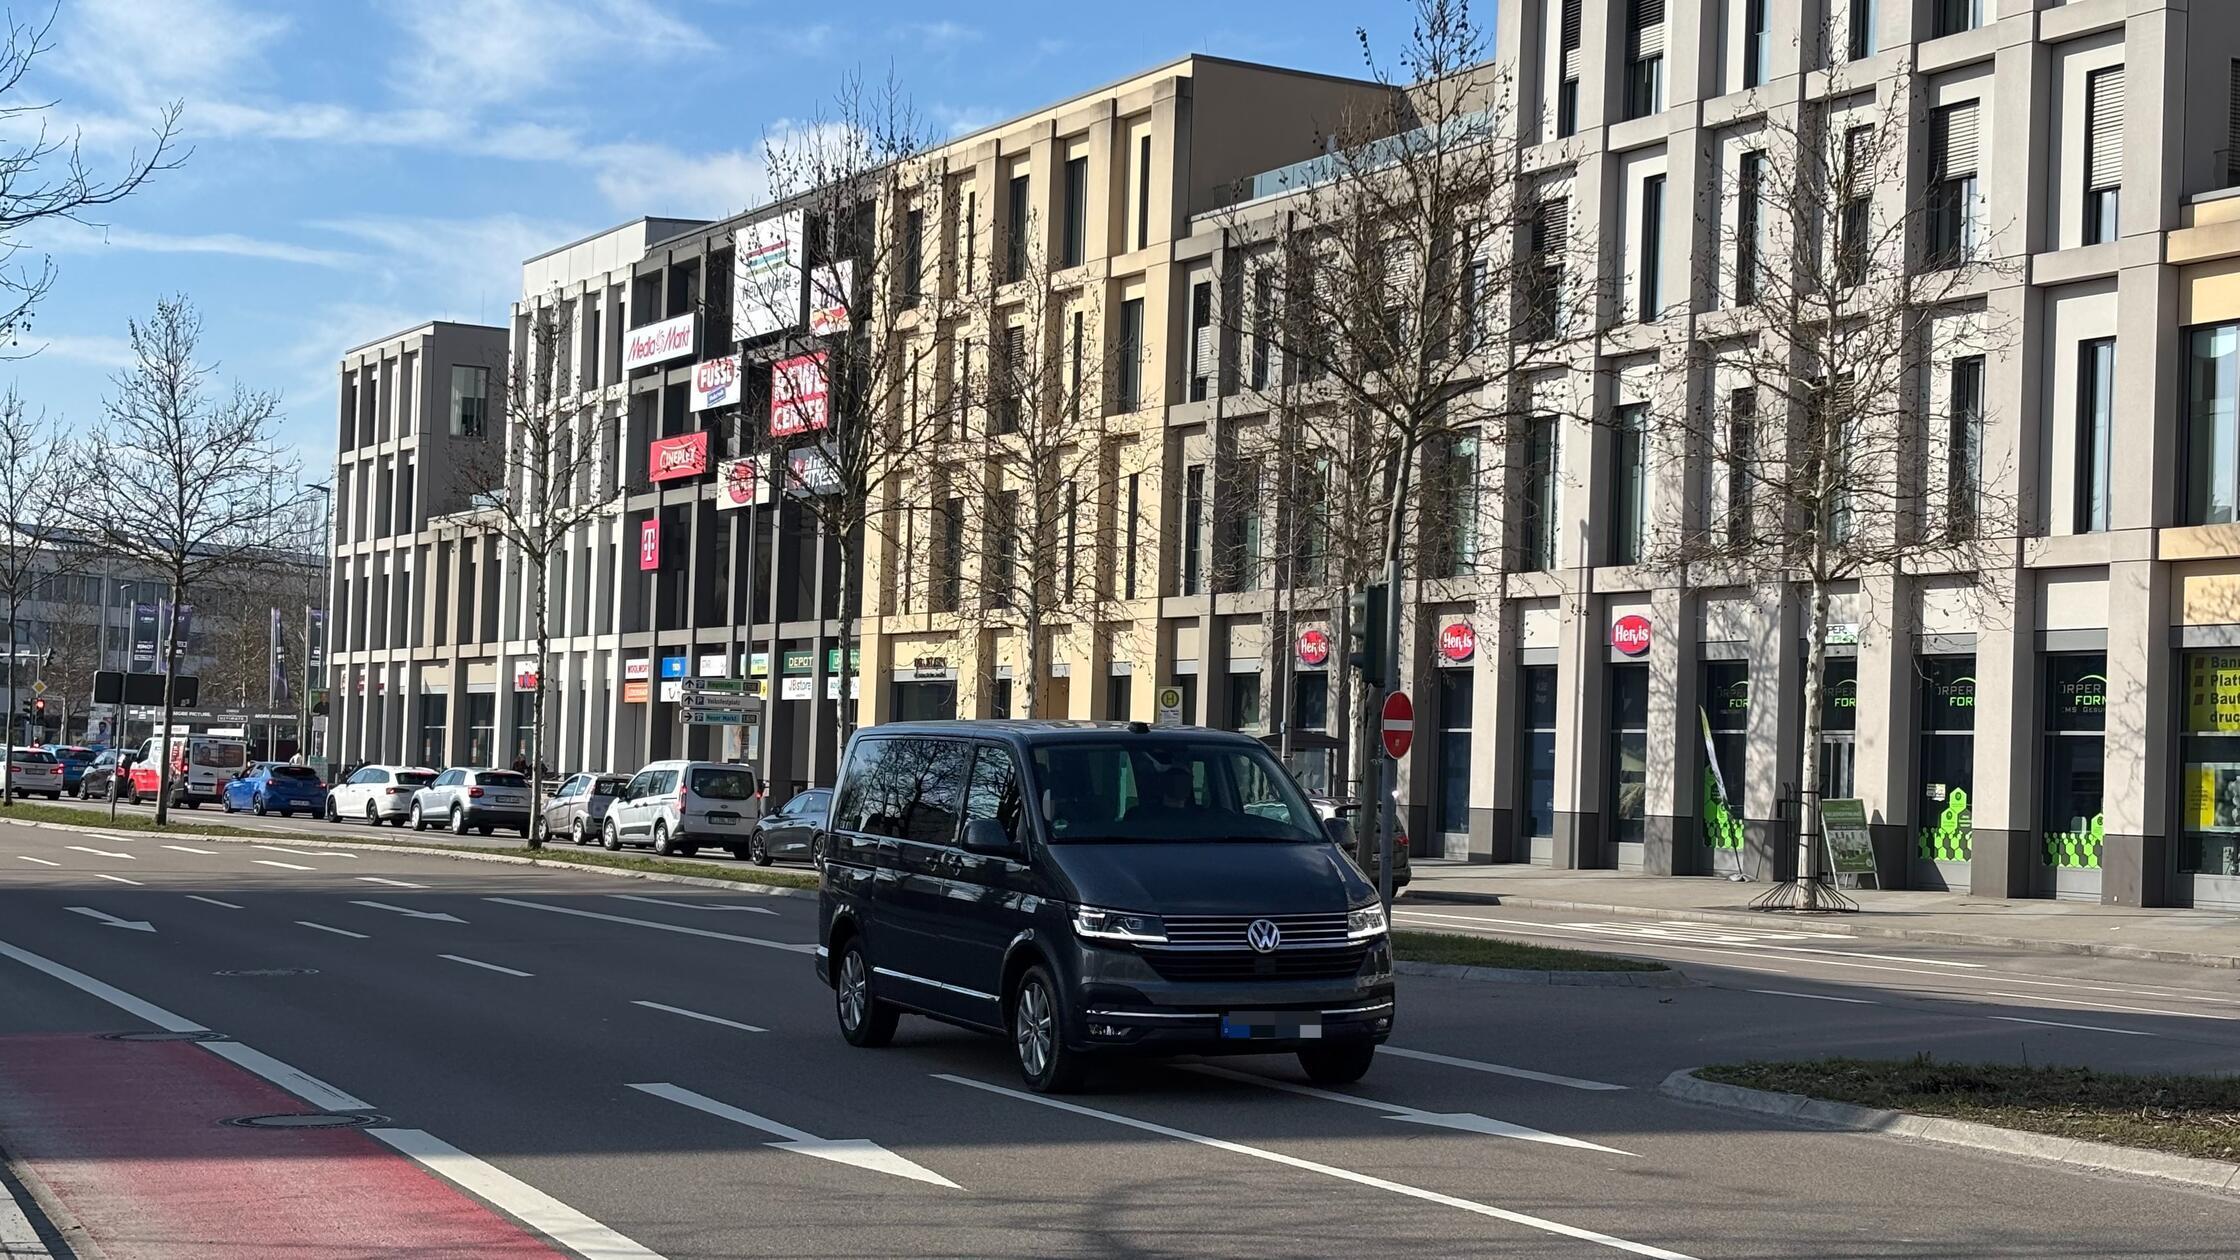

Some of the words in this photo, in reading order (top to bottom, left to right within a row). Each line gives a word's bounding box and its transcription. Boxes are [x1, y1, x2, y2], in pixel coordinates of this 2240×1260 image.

[627, 336, 656, 362] Media
[663, 325, 690, 352] Markt
[1443, 632, 1473, 652] Hervis
[1615, 624, 1649, 646] Hervis
[1300, 637, 1326, 657] Hervis
[788, 657, 813, 668] DEPOT
